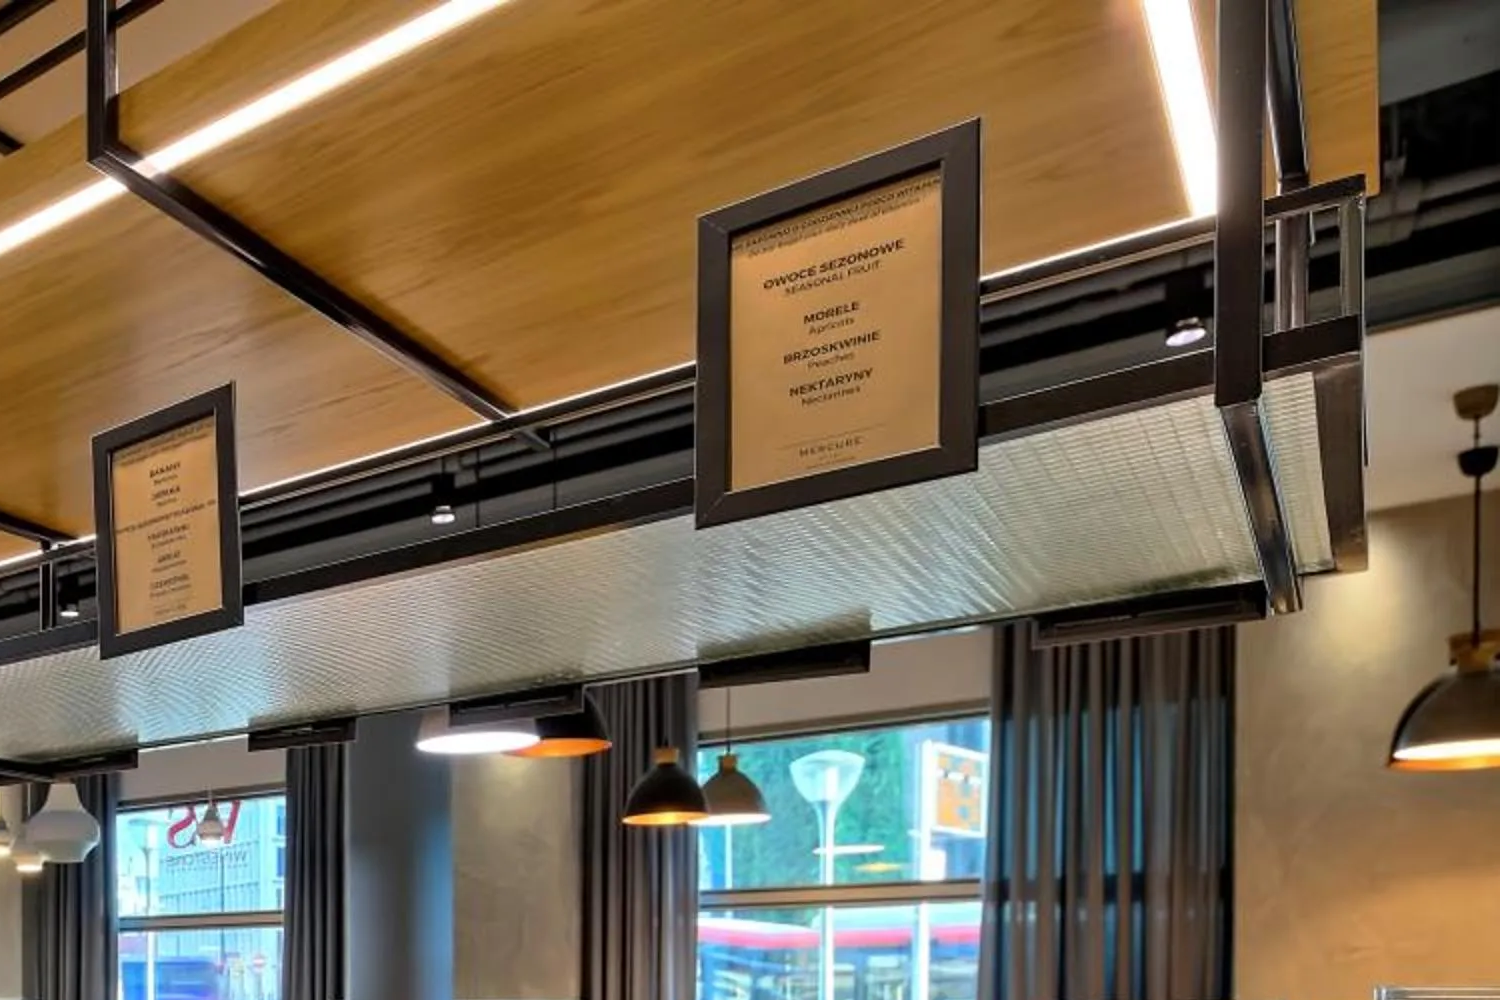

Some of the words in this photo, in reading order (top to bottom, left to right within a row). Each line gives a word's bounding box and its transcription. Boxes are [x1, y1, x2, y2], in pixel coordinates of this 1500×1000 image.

[763, 265, 817, 289] OWOCE
[819, 238, 906, 273] SEZONOWE
[785, 271, 843, 294] SEASONAL
[803, 301, 860, 324] MORELE
[809, 317, 855, 335] Apricots
[783, 330, 882, 365] BRZOSKWINIE
[789, 367, 874, 397] NEKTARYNY
[799, 435, 864, 458] MERCURE
